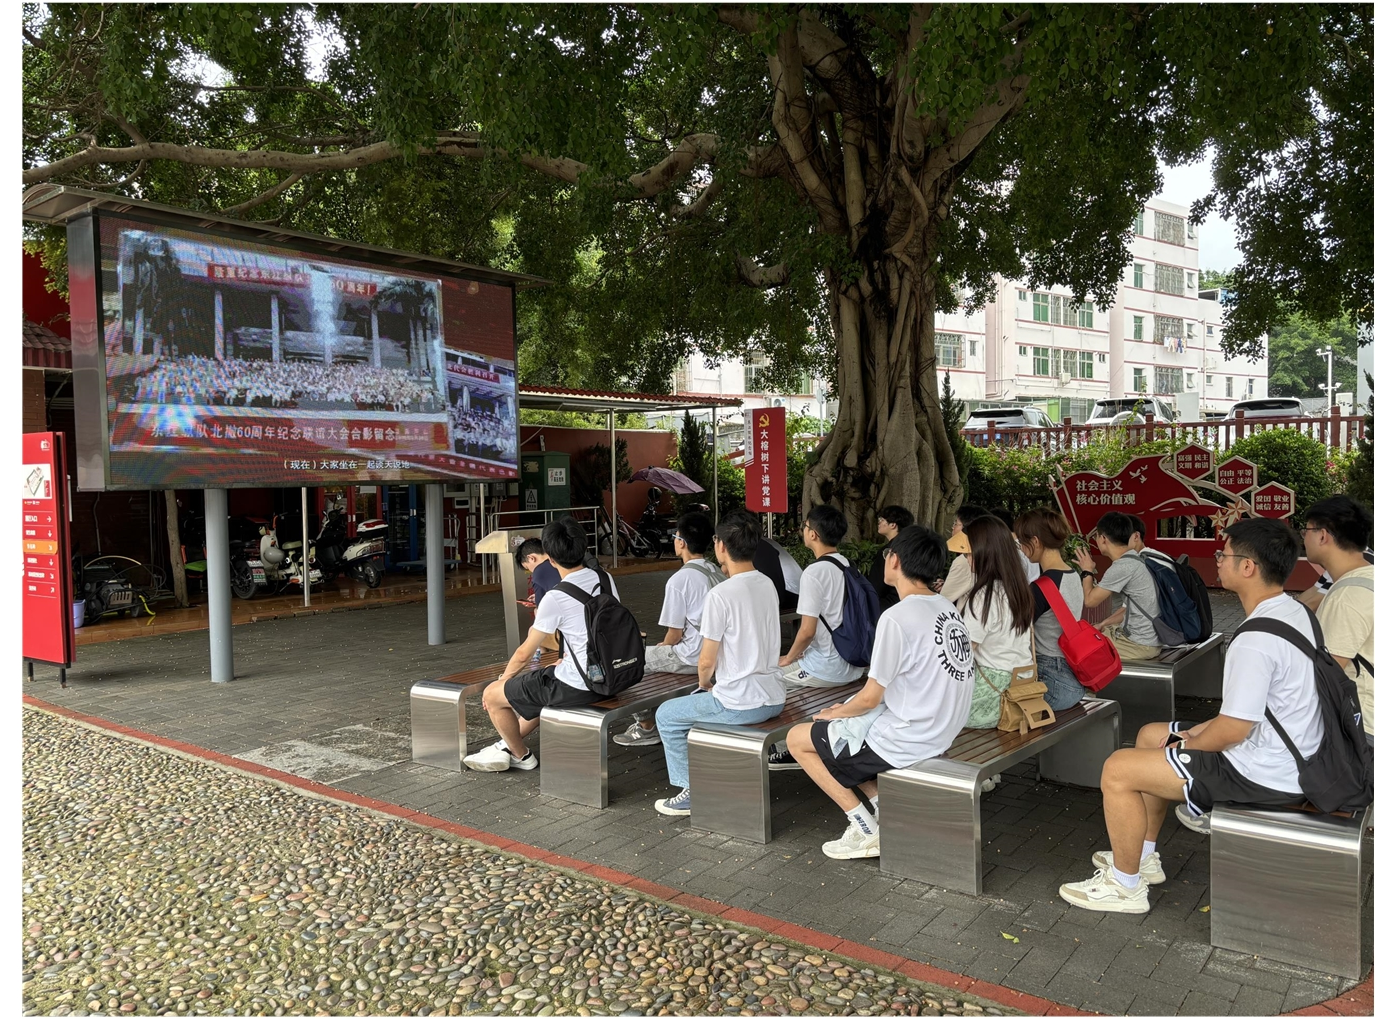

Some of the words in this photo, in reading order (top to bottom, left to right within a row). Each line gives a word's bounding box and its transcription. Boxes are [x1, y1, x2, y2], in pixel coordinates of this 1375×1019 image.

[1177, 454, 1192, 462] 富强
[1194, 454, 1209, 462] 民主
[760, 429, 771, 508] 大榕树下讲党课
[1219, 469, 1235, 477] 自由
[1236, 469, 1252, 477] 平等
[1075, 479, 1124, 492] 社会主义
[1219, 477, 1235, 485] 公正
[1236, 477, 1252, 485] 法治
[1075, 493, 1136, 506] 核心价值观
[1255, 495, 1271, 503] 爱国
[1273, 495, 1290, 503] 敬业
[1255, 503, 1271, 511] 诚信
[1273, 503, 1290, 511] 友善
[934, 612, 950, 646] CHINA
[937, 649, 965, 682] THREE
